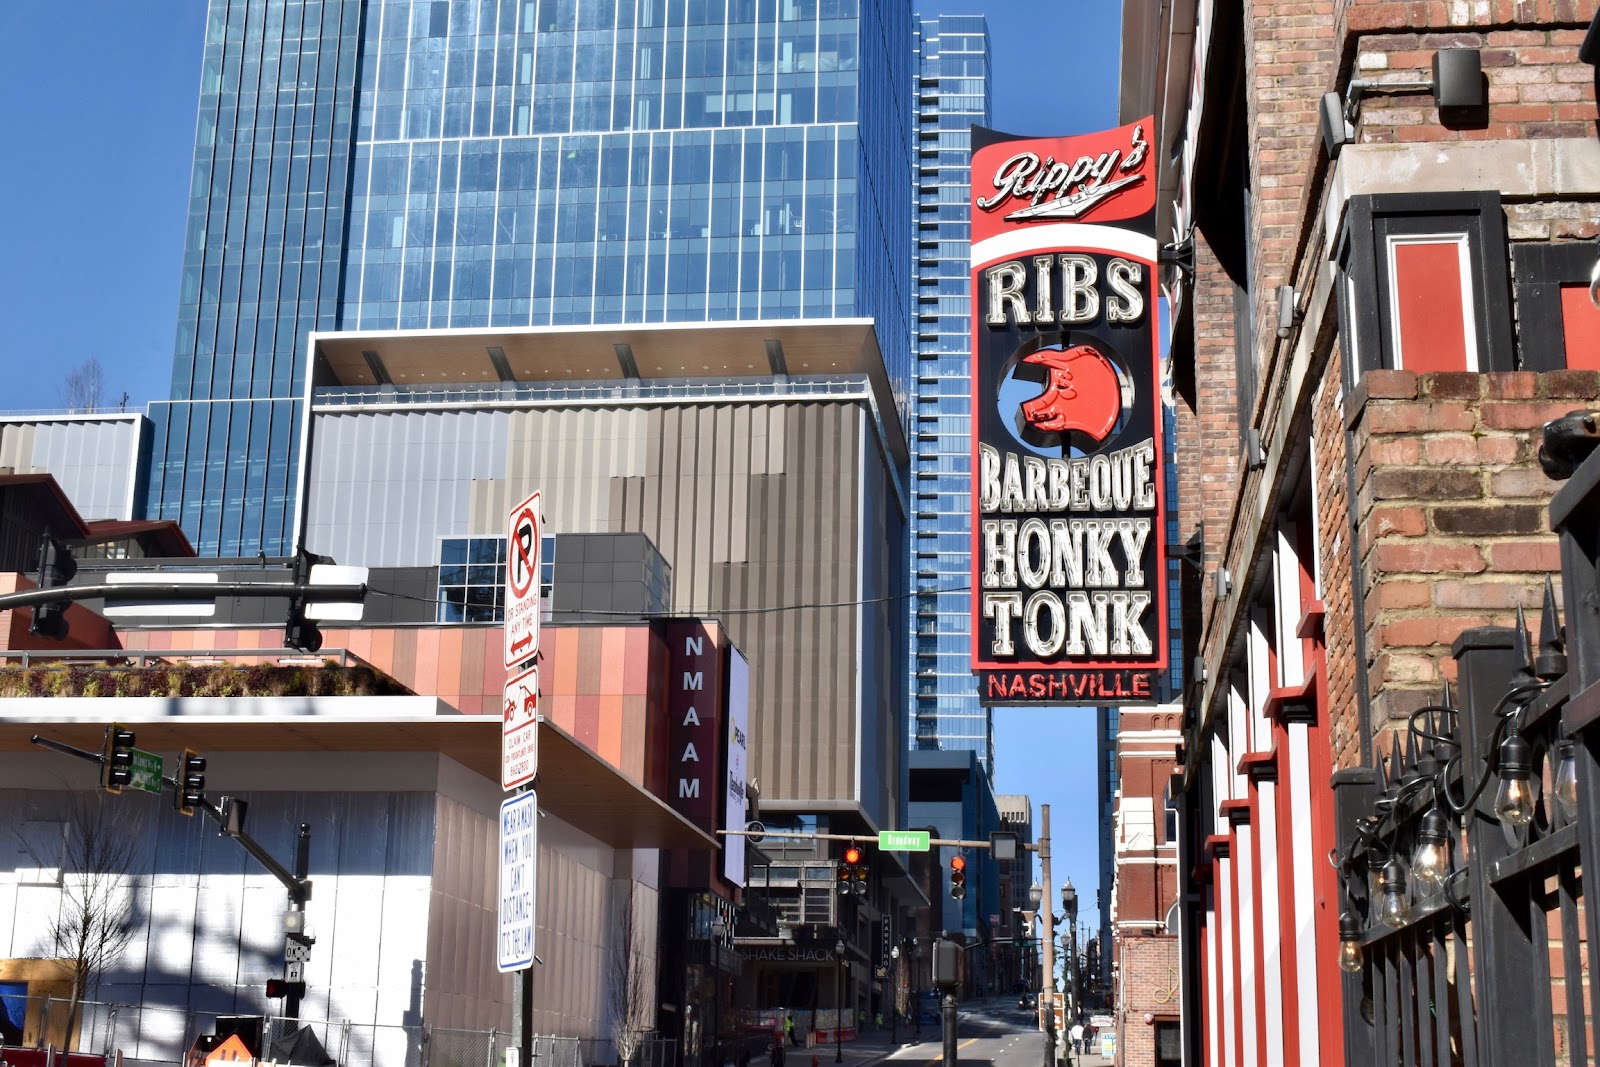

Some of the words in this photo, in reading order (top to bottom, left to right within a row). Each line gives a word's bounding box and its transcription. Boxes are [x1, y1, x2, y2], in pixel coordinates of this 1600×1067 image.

[976, 125, 1150, 207] Rippy's
[986, 254, 1145, 329] RIBS
[979, 437, 1155, 513] BARBEQUE
[982, 518, 1150, 588] HONKY
[515, 592, 537, 617] STANDING
[511, 620, 521, 638] ANY
[522, 612, 533, 630] TIME
[983, 590, 1152, 656] TONK
[988, 673, 1150, 698] NASHVILLE
[679, 637, 703, 798] NMAAM
[523, 729, 531, 743] CAR
[504, 809, 516, 837] WEAR
[521, 801, 533, 831] MASK
[504, 837, 519, 866] WHEN
[522, 832, 532, 860] YOU
[887, 834, 921, 848] Broadway
[287, 947, 297, 958] OK
[512, 928, 520, 956] THE
[521, 925, 531, 955] LAW
[742, 947, 785, 961] SHAKE
[787, 947, 835, 961] SHACK
